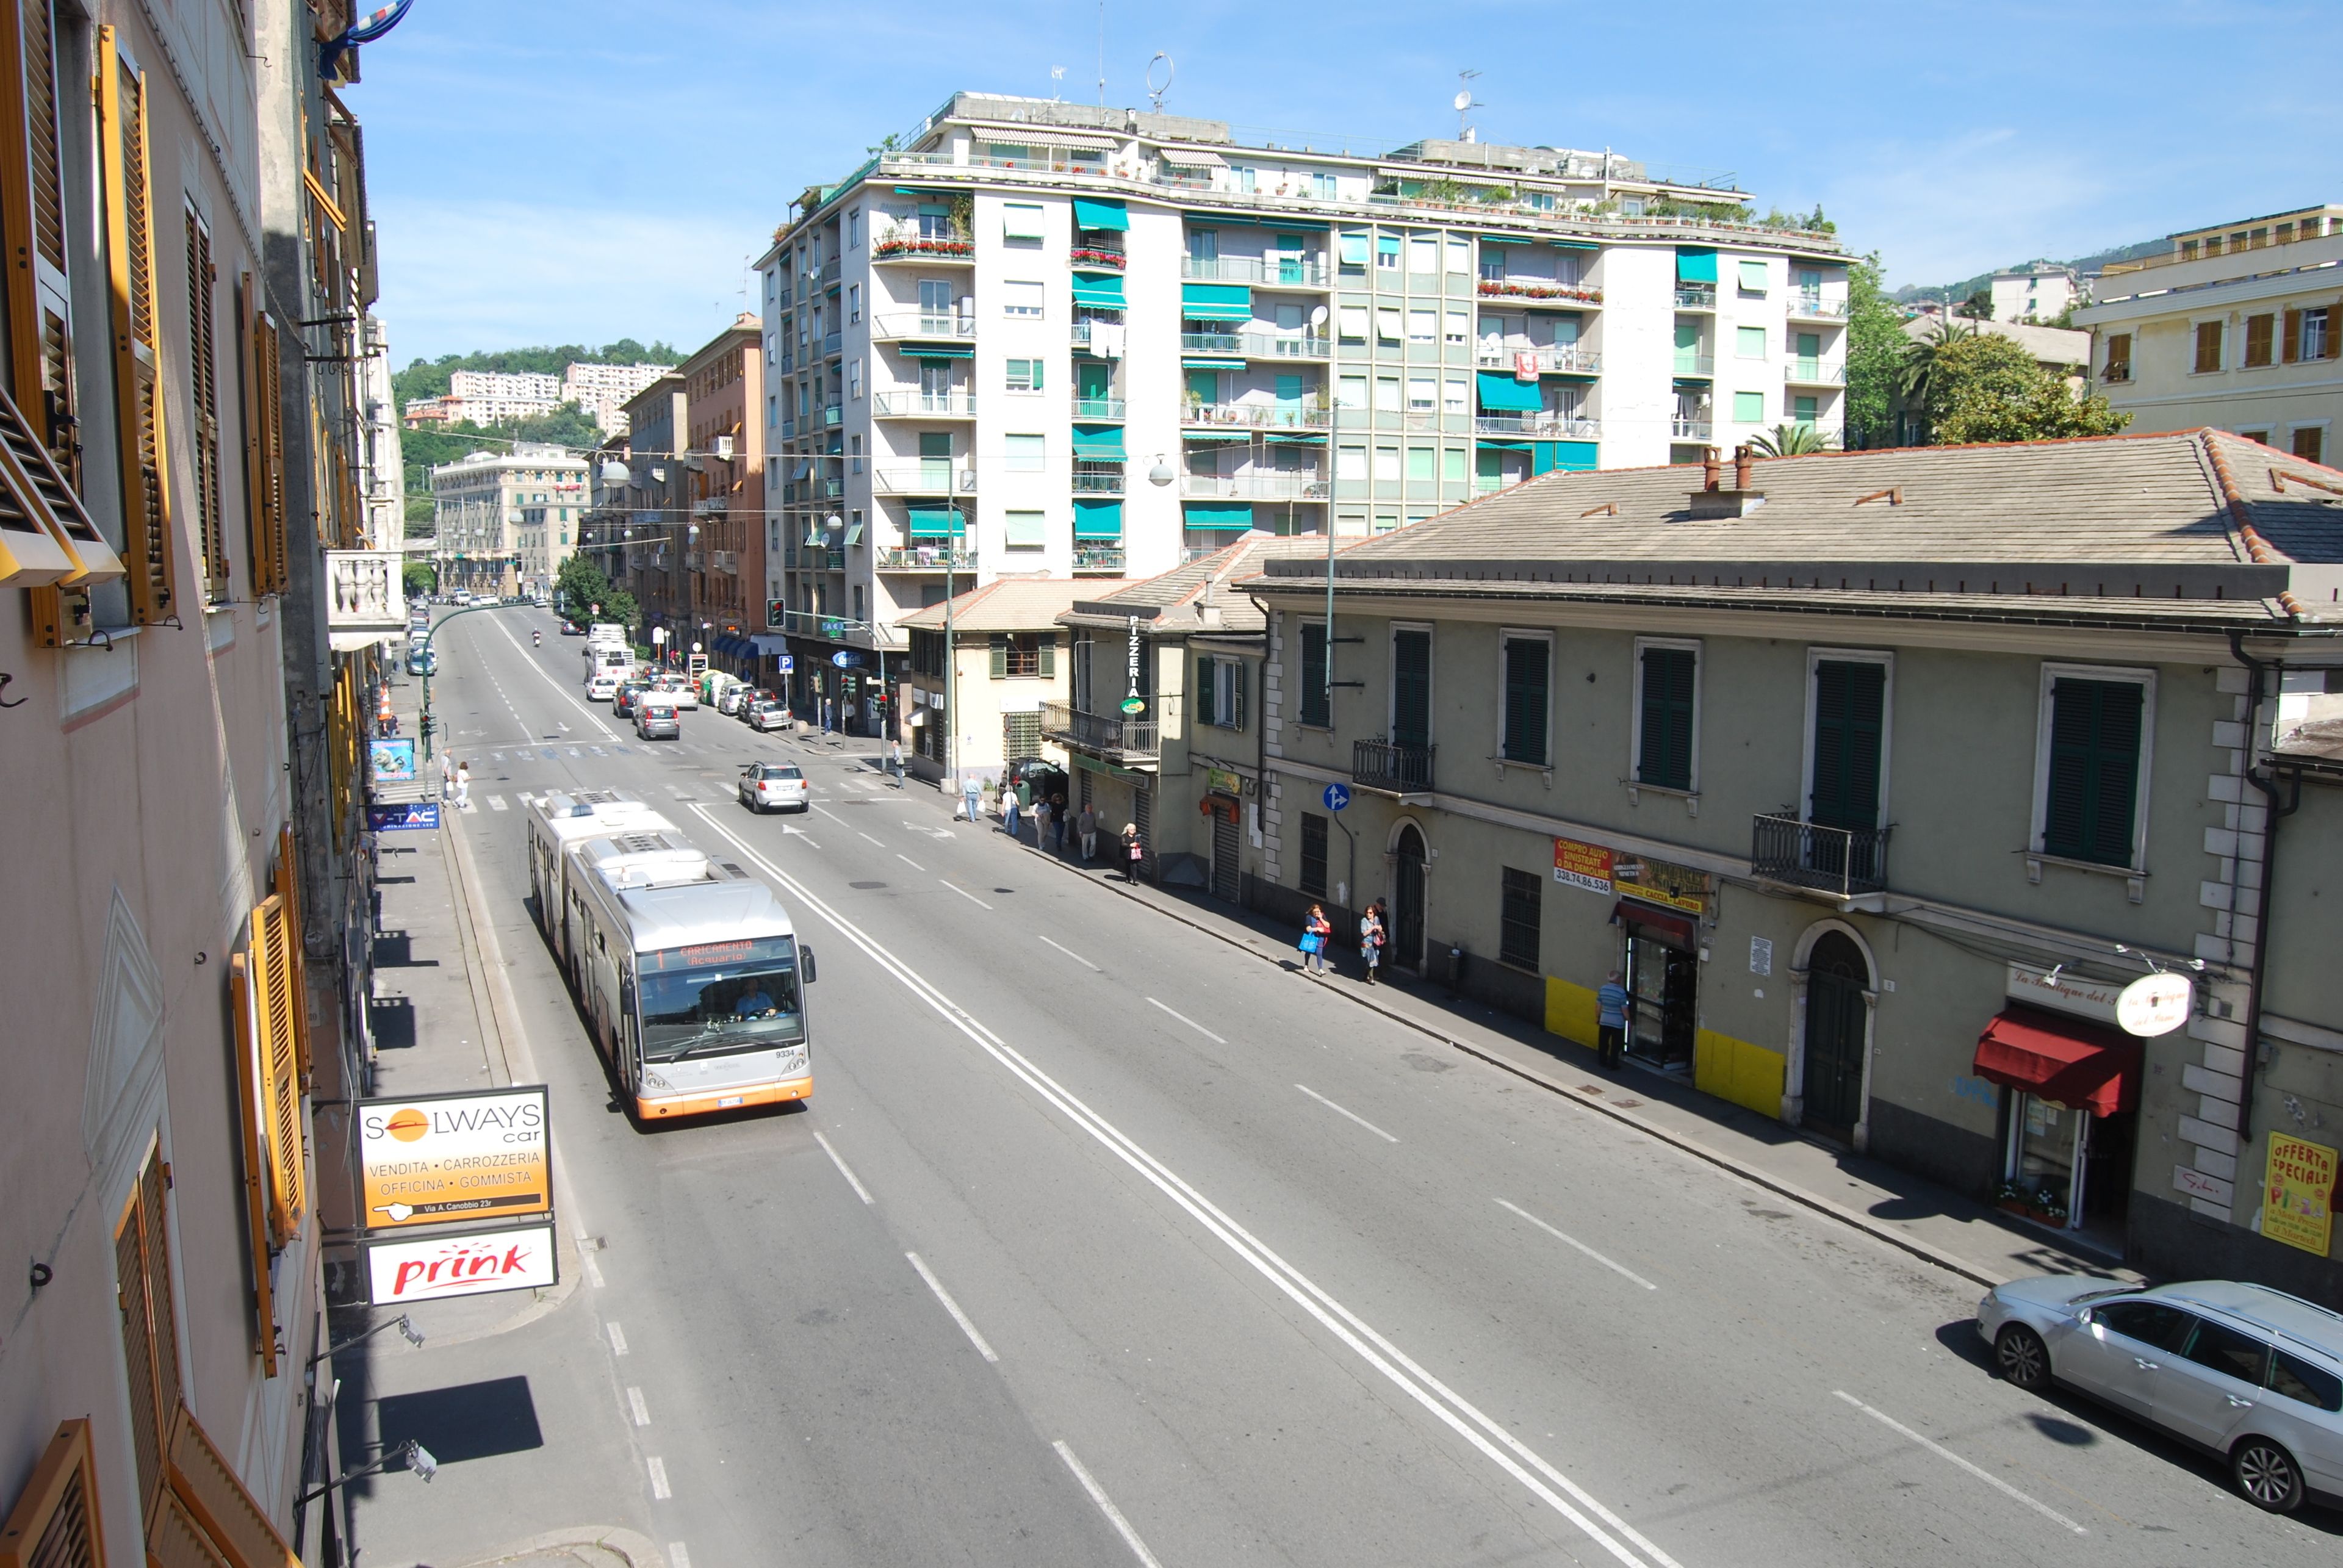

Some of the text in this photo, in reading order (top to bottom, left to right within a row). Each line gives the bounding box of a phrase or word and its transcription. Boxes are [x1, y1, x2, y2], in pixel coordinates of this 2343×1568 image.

[782, 657, 790, 668] P
[1129, 616, 1139, 697] PIZZERIA
[372, 811, 435, 824] V-TAC
[1558, 840, 1608, 860] COMPRO AUTO
[1564, 851, 1601, 866] SINISTRATE
[1557, 859, 1610, 879] O DA DEMOLIRE
[1557, 869, 1609, 891] 338.74.86.536
[1646, 891, 1699, 910] CACCIA LAVORO
[680, 940, 752, 956] CARICAMENTO
[657, 949, 664, 969] 1
[2014, 970, 2028, 984] La
[2086, 990, 2107, 1003] del
[776, 1050, 794, 1059] 9334
[503, 1131, 541, 1143] car
[370, 1153, 540, 1178] VENDITA CARROZZERIA
[2275, 1145, 2329, 1171] OFFERTA
[2272, 1159, 2328, 1185] SPECIALE
[380, 1171, 531, 1196] OFFICINA GOMMISTA
[424, 1204, 436, 1213] Via
[447, 1201, 479, 1212] Canobbio
[480, 1199, 492, 1208] 23r
[2270, 1187, 2324, 1219] PIZZA
[394, 1244, 531, 1295] prink
